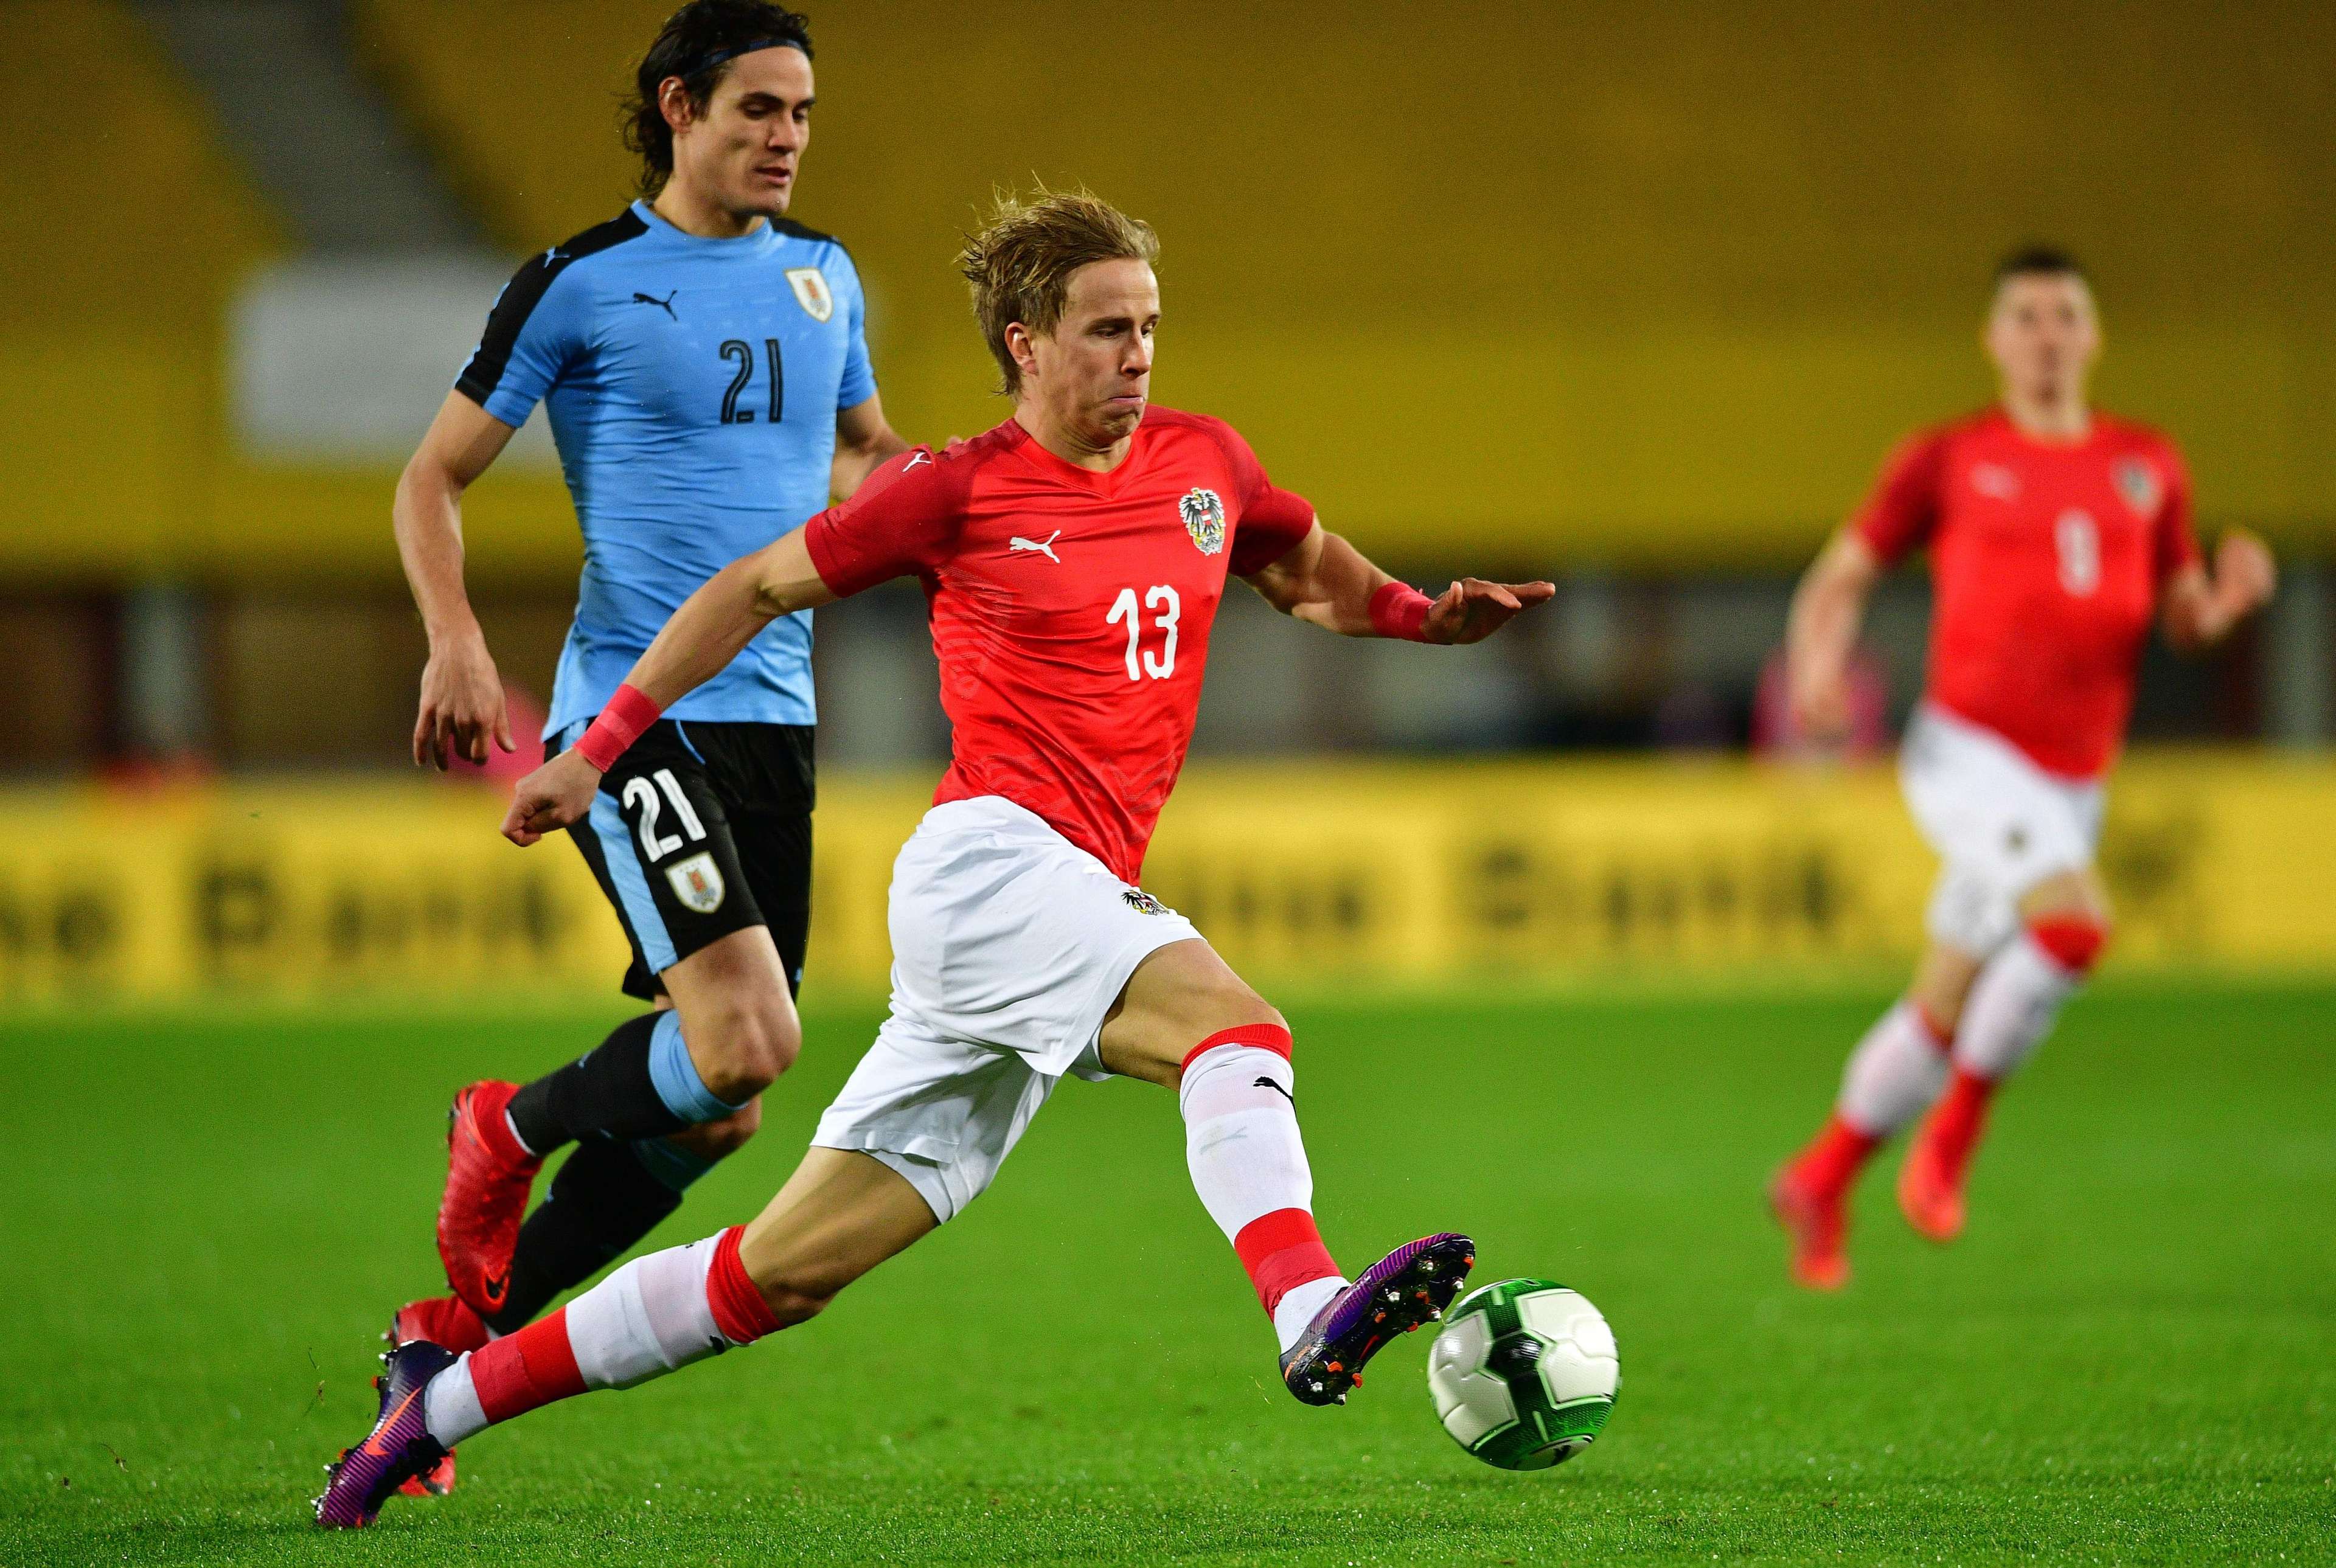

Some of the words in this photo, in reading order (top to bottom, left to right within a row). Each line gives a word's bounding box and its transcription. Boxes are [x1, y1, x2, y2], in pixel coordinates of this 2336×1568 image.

[720, 339, 783, 423] 21
[1106, 585, 1180, 681] 13
[622, 768, 706, 862] 21
